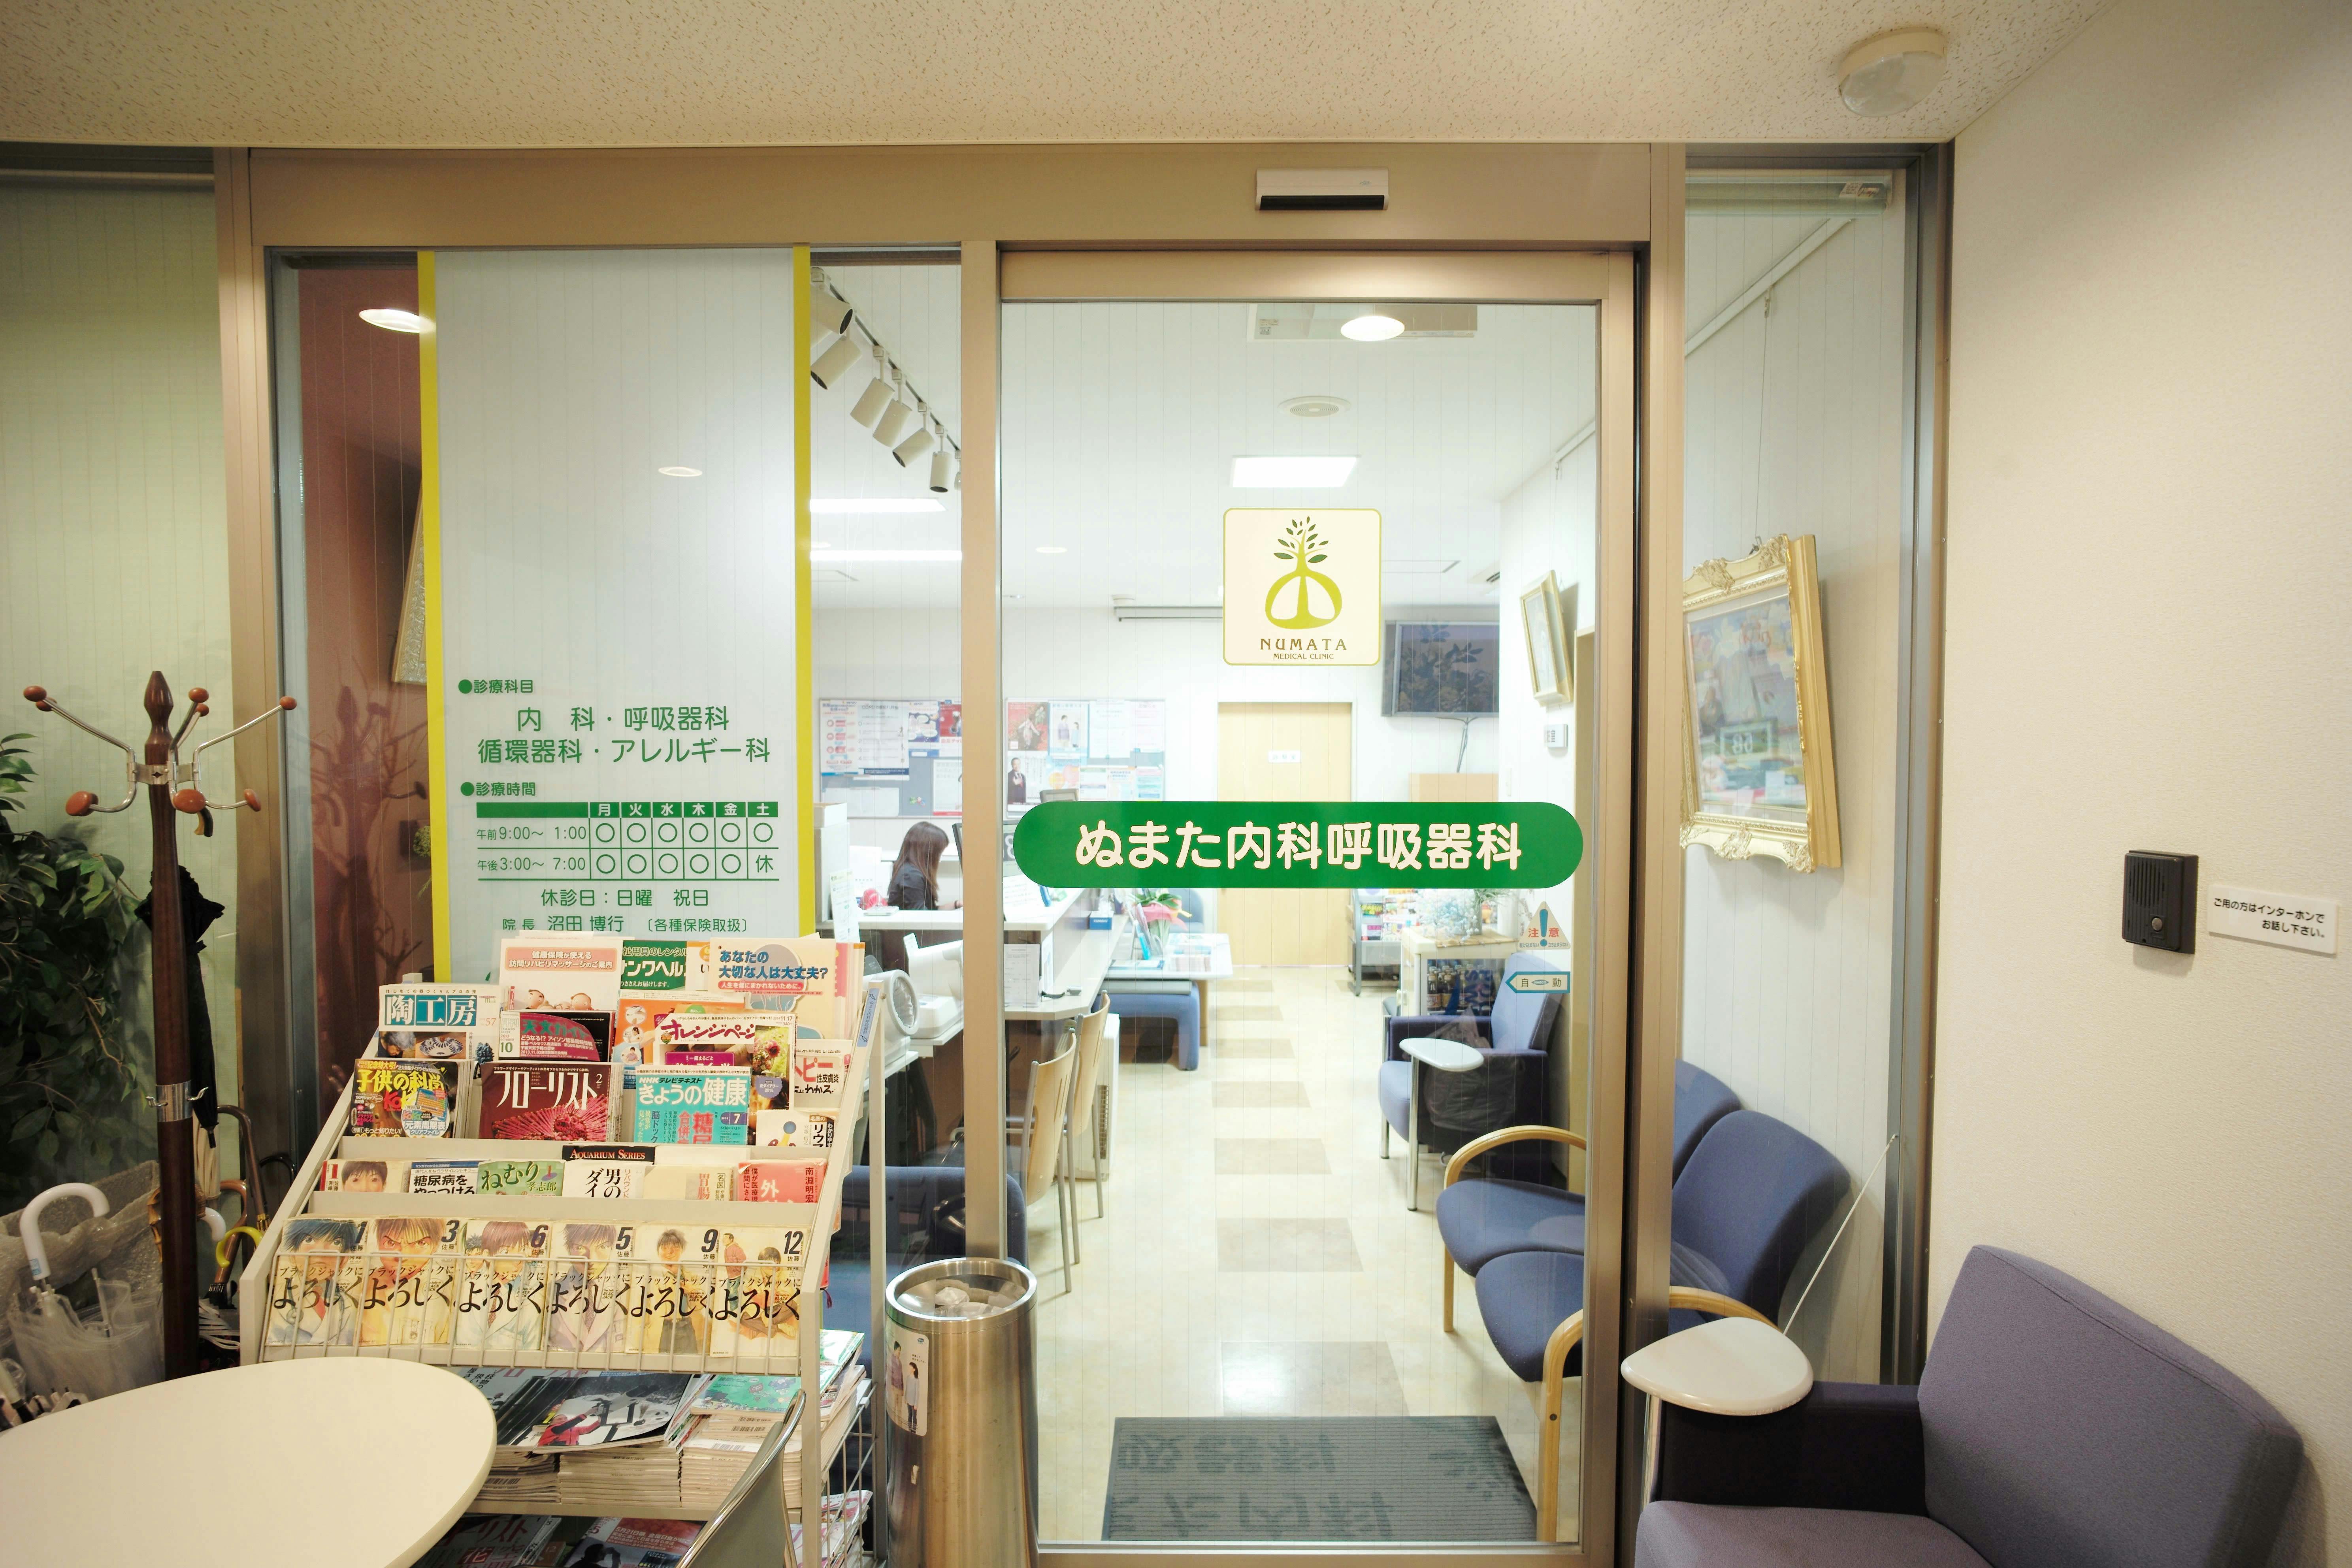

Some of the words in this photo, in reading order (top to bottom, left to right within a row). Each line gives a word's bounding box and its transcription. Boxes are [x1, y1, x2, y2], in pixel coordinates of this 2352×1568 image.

[1261, 639, 1347, 650] NUMATA
[474, 679, 533, 694] 診療科目
[478, 738, 770, 763] 循環器科・アレルギー科
[476, 782, 536, 796] 診療時間
[598, 803, 611, 816] 月
[629, 803, 642, 816] 火
[661, 803, 674, 816] 水
[692, 803, 705, 816] 木
[724, 803, 737, 816] 金
[756, 803, 769, 816] 土
[1076, 820, 1523, 871] ぬまた内科呼吸器科
[756, 854, 774, 873] 休
[673, 889, 709, 907] 祝日
[2214, 897, 2325, 923] ご用の方はインターホンで
[590, 915, 624, 932] 博行
[2262, 919, 2325, 939] お話し下さい。
[509, 960, 613, 969] 訪問リハビリマッサージのご案内
[532, 951, 592, 959] 健康保険が使える
[720, 950, 769, 963] あなたの
[721, 982, 802, 990] 人生を煙にまかれないために。
[386, 995, 477, 1025] 陶工房
[500, 1042, 513, 1052] 10
[357, 1069, 445, 1093] 子供の科学
[494, 1071, 598, 1110] フローリスト
[596, 1073, 603, 1084] 2
[817, 1074, 839, 1083] 性皮膚炎
[638, 1078, 747, 1106] きょうの健康
[404, 1121, 447, 1131] 元素周期表
[651, 1111, 660, 1143] 脳ドック
[734, 1113, 740, 1124] 7
[413, 1174, 468, 1187] 糖尿病を
[481, 1161, 539, 1191] ねむり
[527, 1182, 557, 1192] 孝志郎
[584, 1168, 604, 1198] ダイ
[604, 1168, 621, 1198] 男の
[623, 1168, 631, 1199] リバウンド
[697, 1173, 710, 1200] 胃腸
[717, 1174, 725, 1189] 名医
[805, 1167, 814, 1203] 南淵明宏
[355, 1221, 368, 1244] 1
[441, 1219, 460, 1243] 3
[531, 1224, 549, 1248] 6
[615, 1227, 633, 1250] 5
[701, 1229, 718, 1253] 9
[784, 1231, 803, 1255] 12
[465, 1271, 545, 1281] ブラックジャクに
[273, 1276, 362, 1310] よろしく
[364, 1275, 454, 1310] よろしく
[459, 1281, 544, 1314] よろしく
[546, 1283, 631, 1315] よろしく
[631, 1285, 715, 1319] よろしく
[715, 1287, 801, 1321] よろしく
